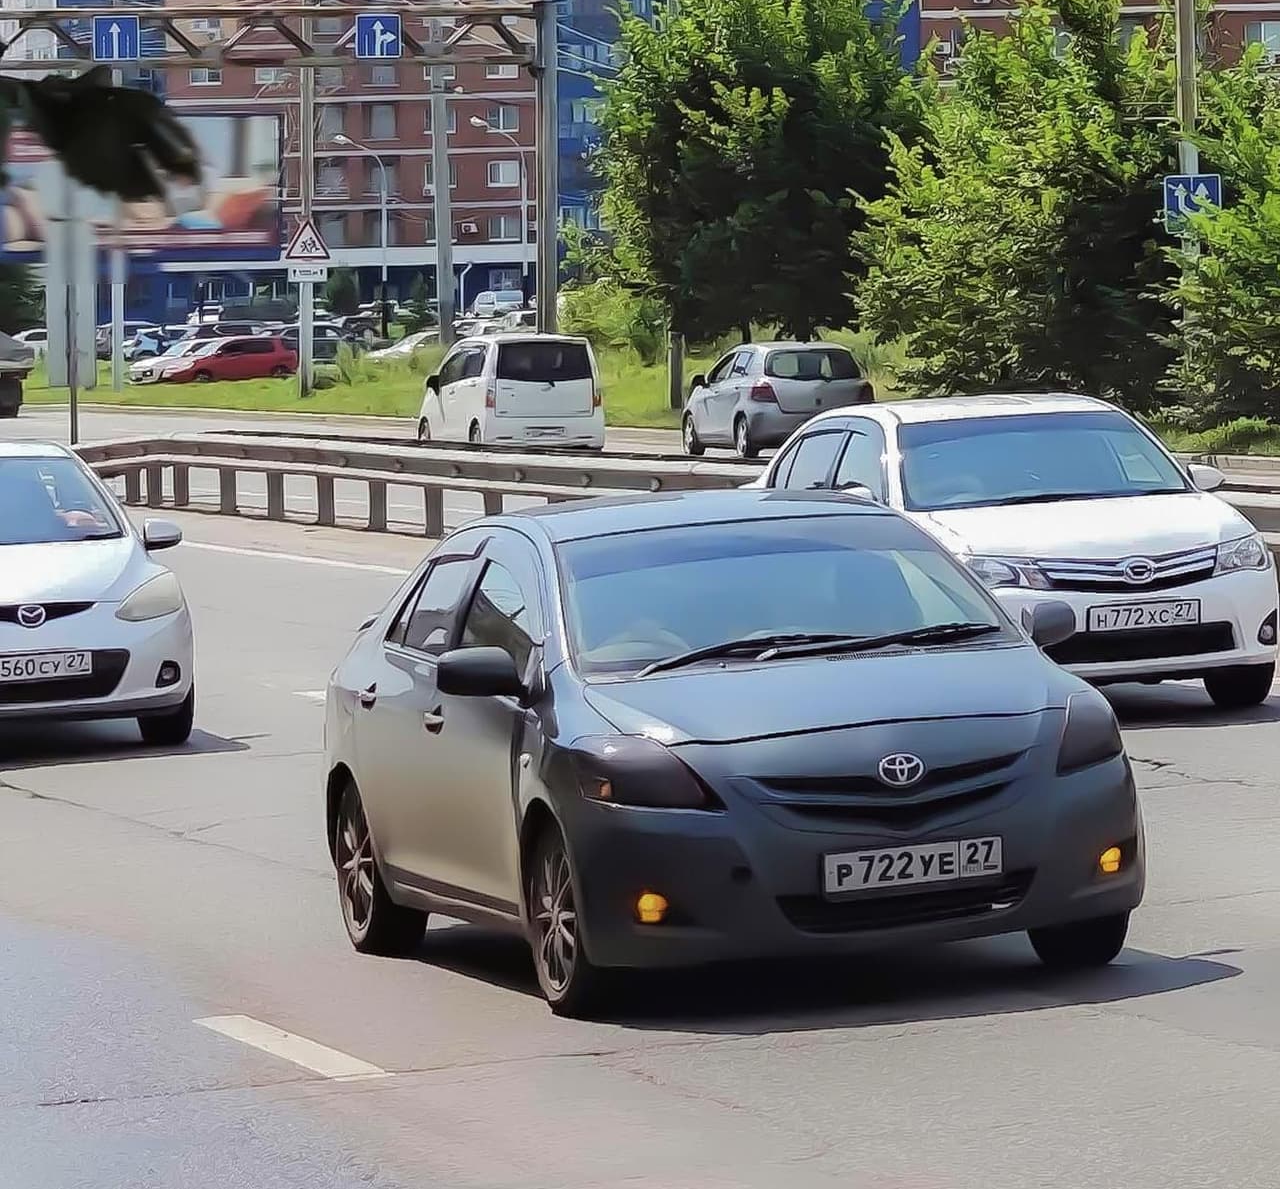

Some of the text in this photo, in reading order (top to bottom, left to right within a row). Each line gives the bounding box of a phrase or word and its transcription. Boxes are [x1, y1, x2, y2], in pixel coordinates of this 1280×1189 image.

[1174, 602, 1192, 617] 27
[67, 653, 85, 668] 27
[966, 840, 993, 865] 27
